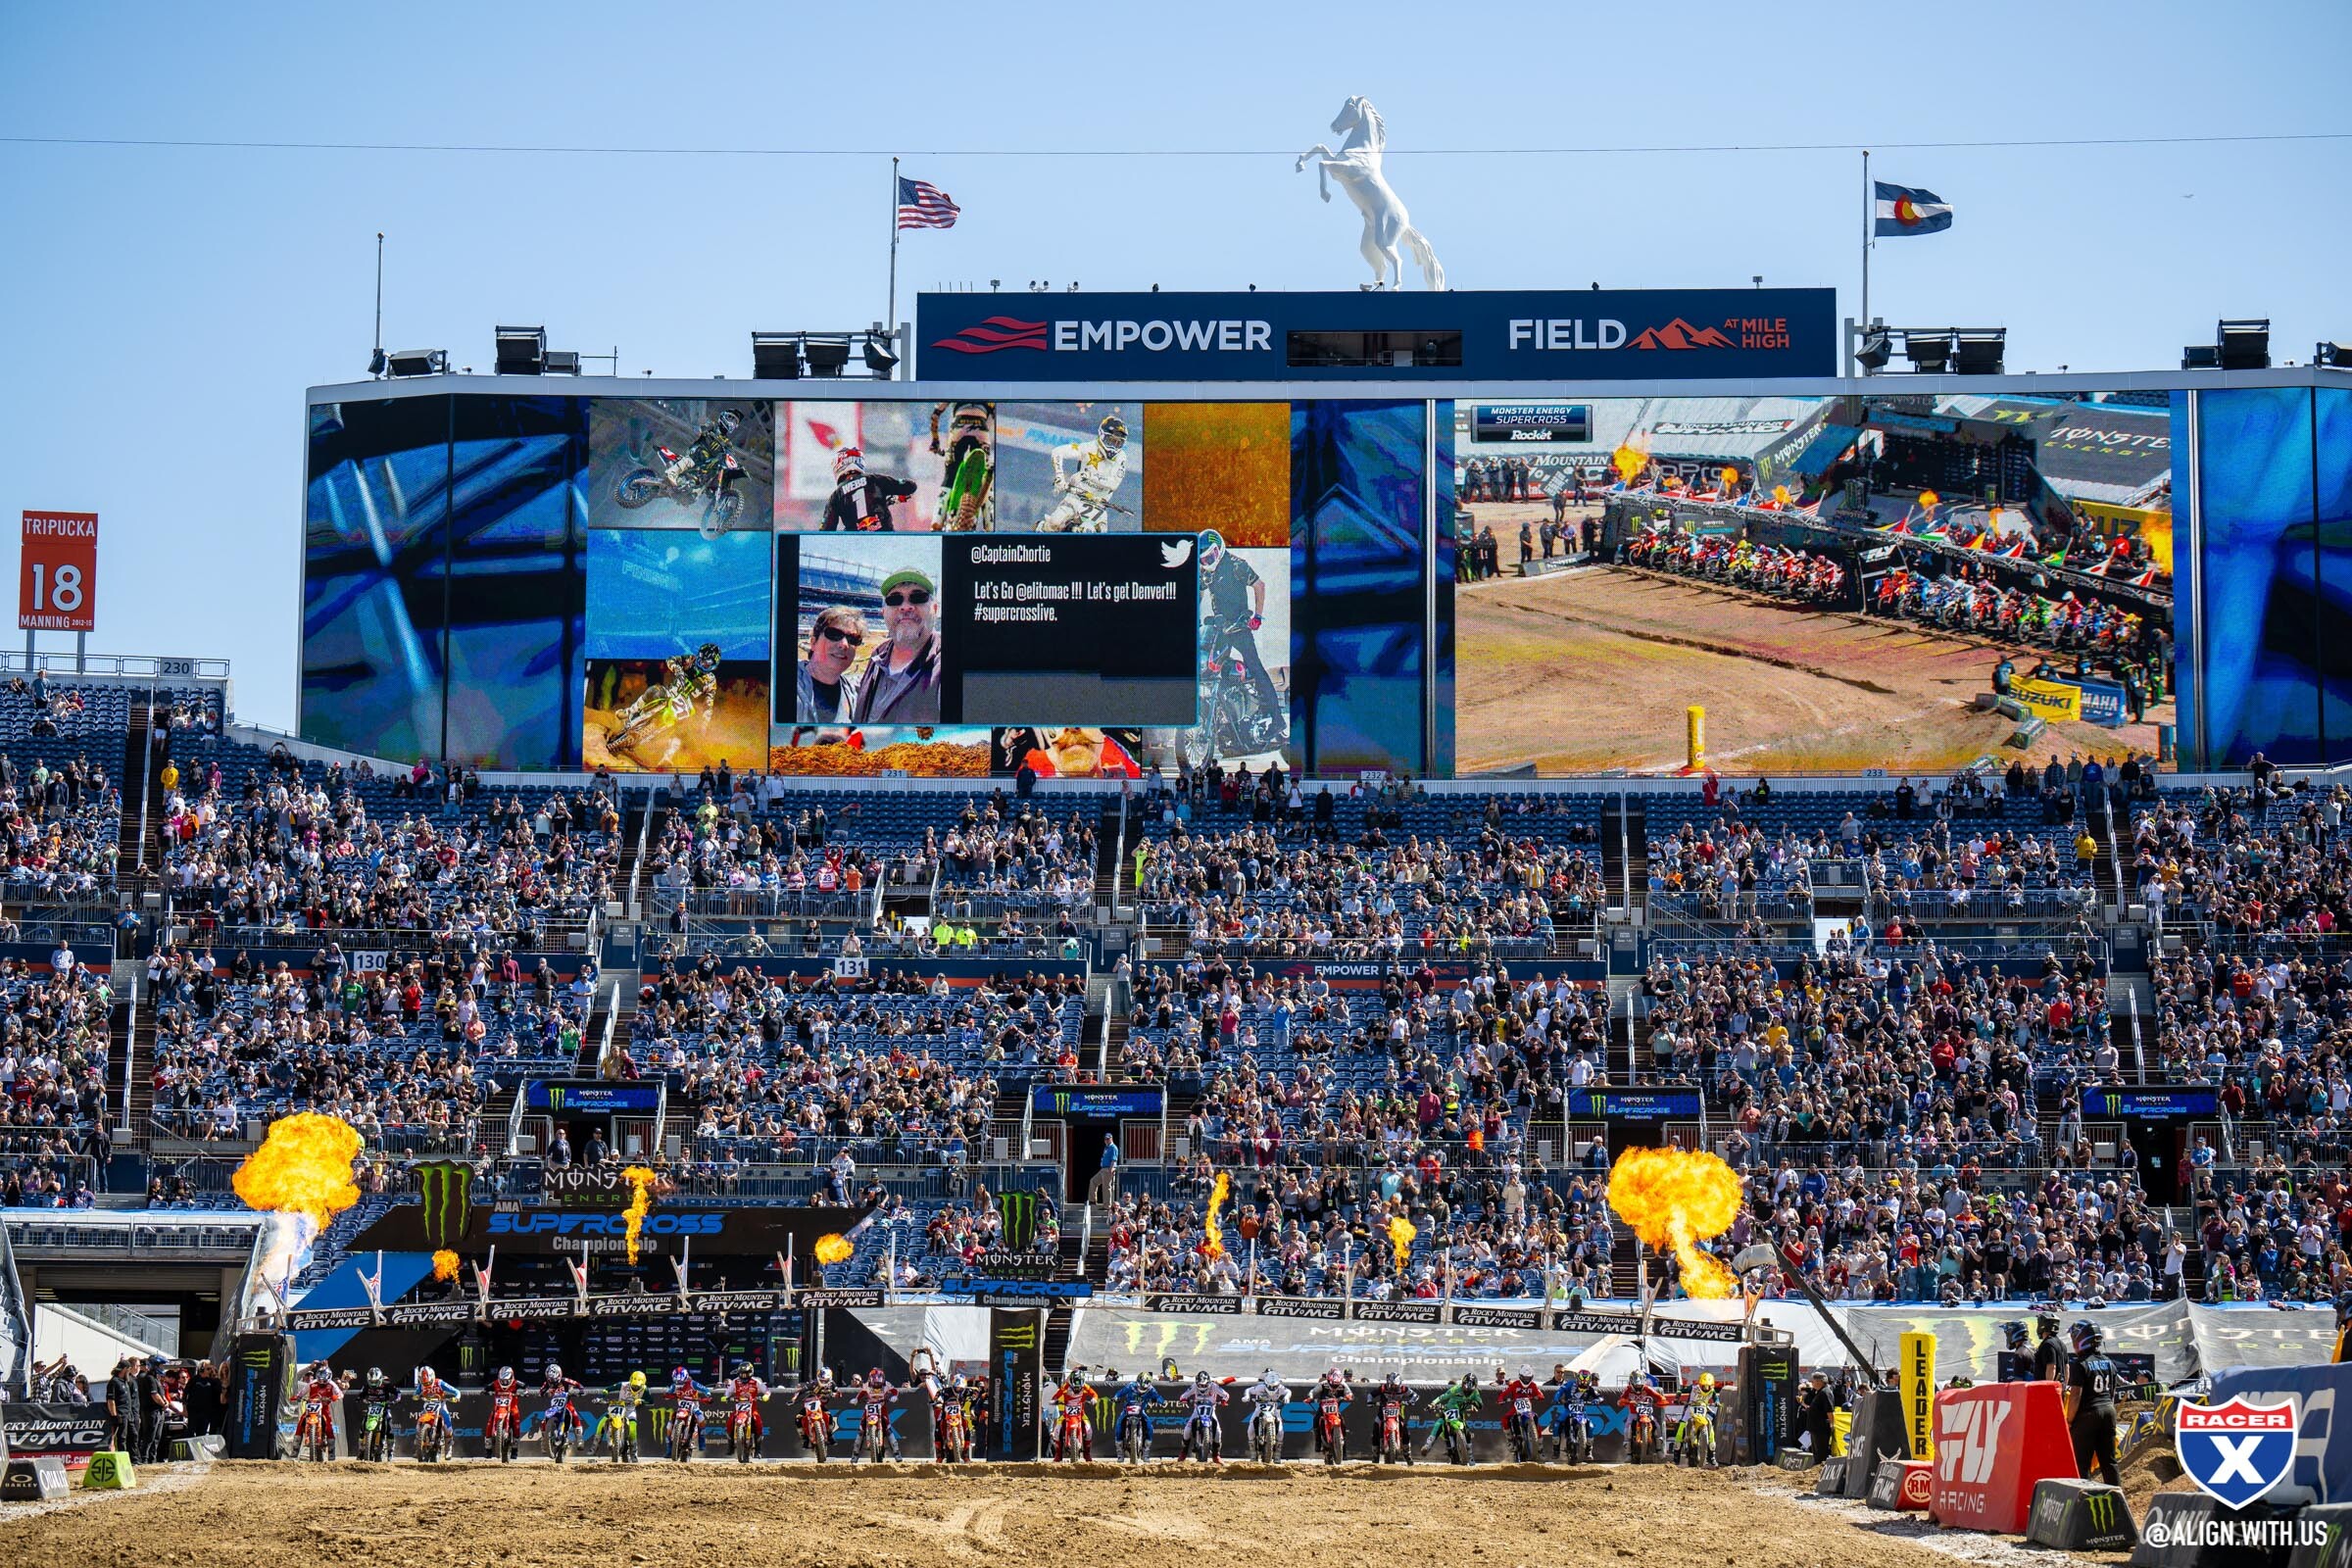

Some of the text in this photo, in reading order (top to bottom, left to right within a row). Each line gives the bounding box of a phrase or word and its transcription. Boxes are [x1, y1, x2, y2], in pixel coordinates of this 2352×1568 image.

[1724, 318, 1787, 333] AT MILE
[1054, 319, 1627, 351] EMPOWER FIELD
[1741, 334, 1789, 349] HIGH
[1495, 416, 1567, 424] SUPERCROSS
[1510, 428, 1552, 440] Rocket
[2050, 426, 2171, 450] ONSTE
[1535, 455, 1609, 466] MOUNTAIN
[843, 477, 867, 494] WEBB
[852, 488, 867, 518] 1
[1079, 503, 1103, 521] 27
[24, 517, 95, 537] TRIPUCKA
[971, 545, 1051, 564] @CaptainChortie
[32, 564, 83, 612] 18
[974, 581, 999, 600] Let's
[1001, 583, 1014, 600] Go
[1015, 581, 1069, 602] @elitomac
[1087, 581, 1111, 600] Let's
[1113, 583, 1130, 602] get
[1131, 581, 1176, 600] Denver!!!
[974, 604, 1057, 623] #supercrosslive.
[21, 614, 70, 628] MANNING
[164, 662, 190, 674] 230
[2082, 692, 2118, 711] MAHA
[357, 955, 385, 969] 130
[839, 961, 866, 975] 131
[1314, 965, 1420, 976] EMPOWER FELD
[545, 1168, 672, 1190] MONSR
[494, 1202, 519, 1212] AMA
[553, 1236, 658, 1253] Championhip
[976, 1253, 1056, 1267] MONSTER
[942, 1279, 1093, 1297] SUPERCROSS
[529, 1300, 568, 1309] MOUNTAIN
[631, 1296, 671, 1304] MOUNTAIN
[983, 1295, 1050, 1307] Championship
[1299, 1300, 1340, 1310] MOUNTAIN
[330, 1309, 370, 1319] MOUNTAIN
[428, 1304, 468, 1313] MOUNTAIN
[1396, 1303, 1436, 1313] MOUNTAIN
[1495, 1310, 1536, 1319] MOUNTAIN
[1597, 1316, 1638, 1325] MOUNTAIN
[1309, 1325, 1522, 1338] MONSTER
[1696, 1322, 1738, 1332] MOUNTAIN
[1215, 1344, 1585, 1355] SUPERCROS
[1331, 1354, 1504, 1366] Championship
[553, 1398, 564, 1407] 26
[1003, 1349, 1013, 1453] SUPERCROSS
[1021, 1372, 1033, 1428] MONSTER
[1915, 1341, 1928, 1455] LEADER
[258, 1385, 268, 1426] MONSTER
[679, 1400, 692, 1409] 95
[808, 1402, 816, 1411] 1
[867, 1404, 879, 1413] 51
[948, 1405, 959, 1414] 25
[1067, 1406, 1080, 1415] 23
[1128, 1405, 1139, 1414] 3
[1199, 1406, 1211, 1415] 11
[1515, 1399, 1530, 1410] 285
[1446, 1410, 1457, 1419] 21
[4, 1419, 106, 1431] CKY MOUNTAIN
[1939, 1400, 2011, 1484] FLY
[1911, 1479, 1931, 1494] RM
[1939, 1492, 1986, 1513] RACING
[2085, 1534, 2126, 1545] MONSTER
